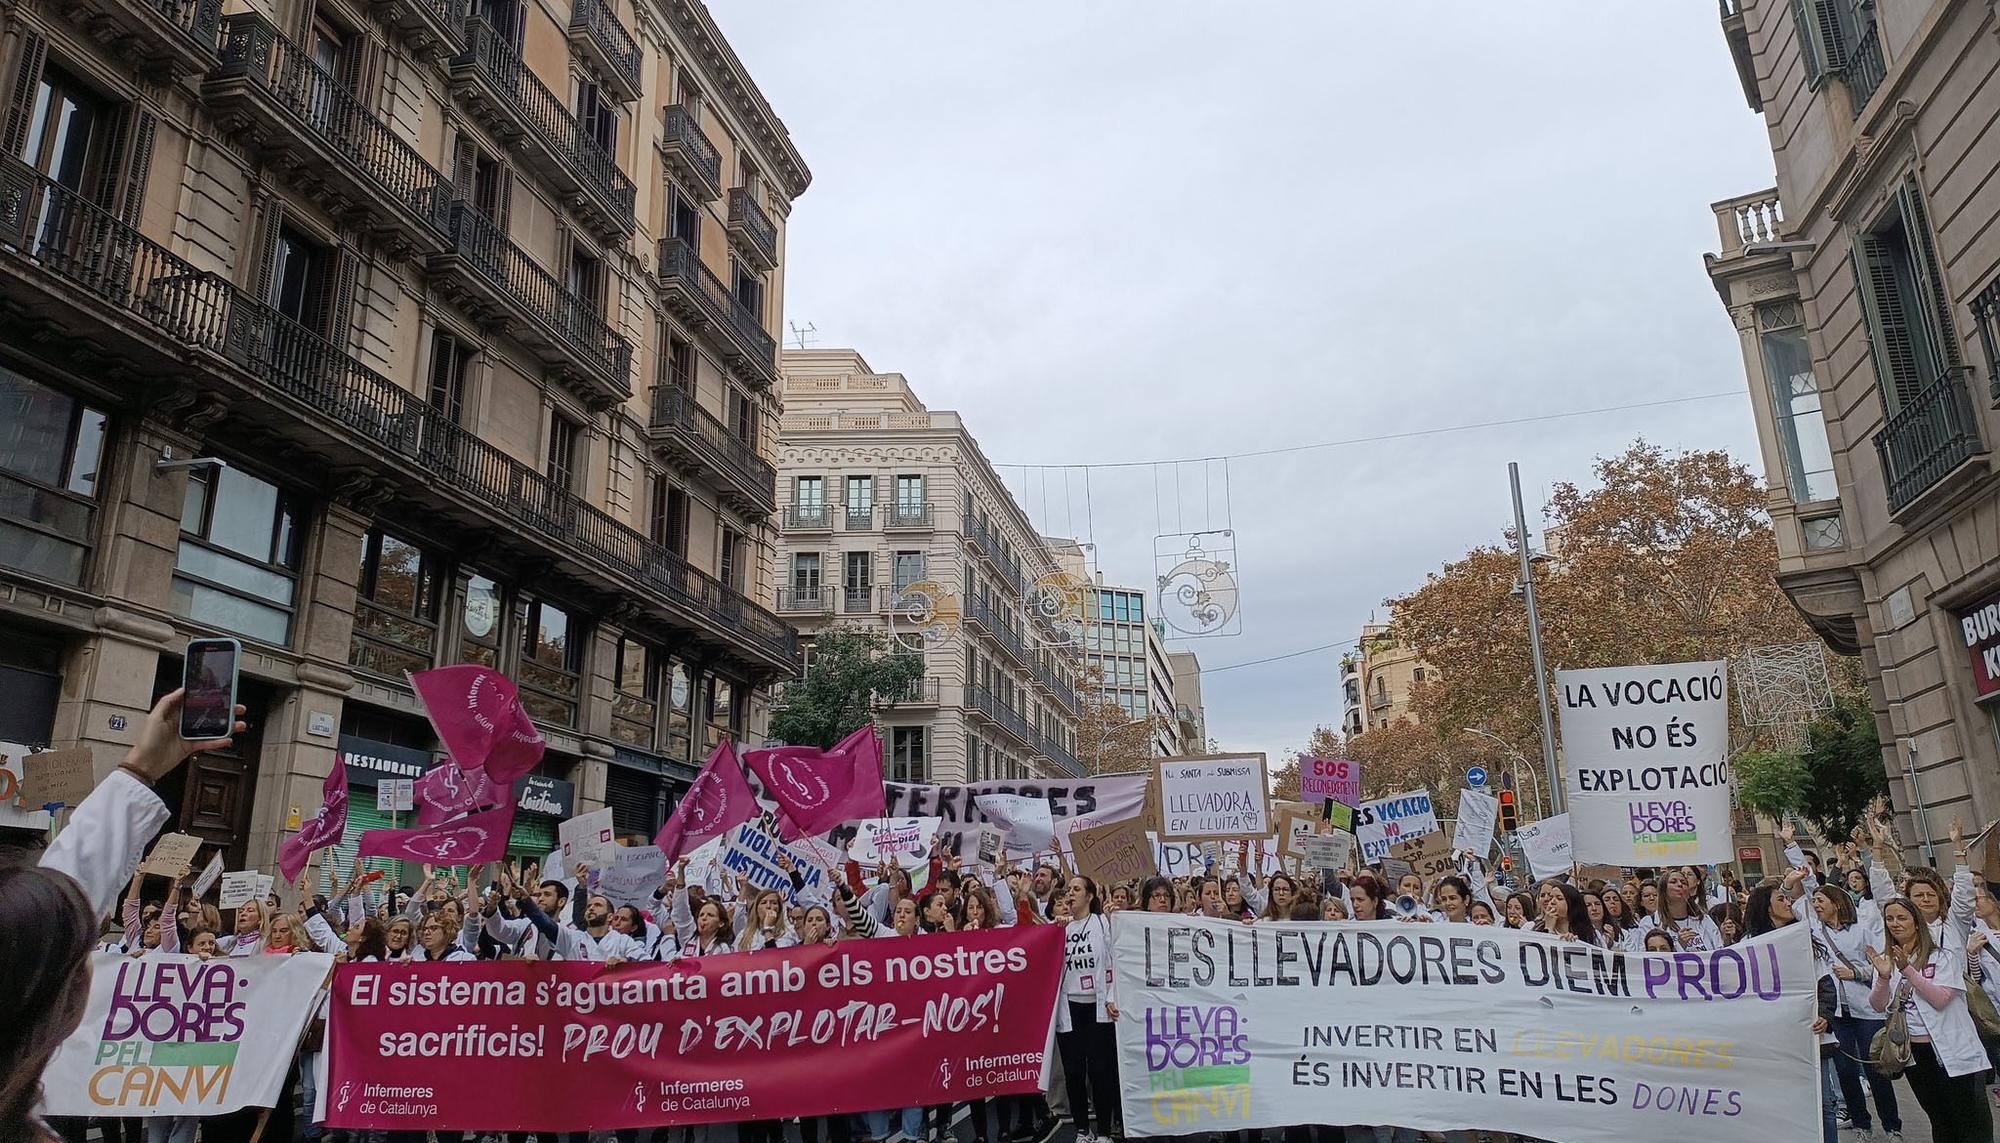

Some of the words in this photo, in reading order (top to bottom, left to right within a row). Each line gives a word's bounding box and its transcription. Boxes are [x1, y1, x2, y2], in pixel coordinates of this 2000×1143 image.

[1962, 601, 2000, 647] BUR
[1565, 684, 1597, 708] LA
[1602, 668, 1722, 707] VOCACIÓ
[1611, 725, 1656, 750] NO
[1666, 716, 1697, 748] ÉS
[344, 752, 422, 777] RESTAURANT
[1180, 768, 1201, 779] SANTA
[1217, 767, 1251, 777] SUBMISSA
[1313, 760, 1349, 779] SOS
[1578, 755, 1728, 791] EXPLOTACIÓ
[1170, 790, 1251, 813] LLEVADORA
[1171, 819, 1188, 831] EN
[1199, 814, 1240, 830] LLUITA
[1383, 822, 1400, 838] NO
[1631, 815, 1696, 835] DORES
[1633, 832, 1657, 844] PEL
[1116, 844, 1137, 862] DIEM
[1065, 944, 1092, 956] LIKE
[1066, 958, 1095, 971] THIS
[1145, 927, 1215, 988] LES
[1228, 928, 1505, 988] LLEVADORES
[1519, 940, 1631, 996] DIEM
[1643, 943, 1781, 1001] PROU
[351, 975, 381, 1006] El
[388, 974, 526, 1006] sistema
[535, 972, 707, 1014] s'aguanta
[720, 960, 806, 998] amb
[818, 954, 873, 989] els
[885, 946, 1028, 982] nostres
[102, 1000, 246, 1042] DORES
[379, 1024, 545, 1057] sacrificis!
[562, 1022, 664, 1063] PROU
[678, 982, 1005, 1055] D'EXPLOTAR-NOS!
[1303, 1024, 1442, 1051] INVERTIR
[1454, 1027, 1498, 1053] EN
[95, 1041, 149, 1066] PEL
[966, 1052, 1043, 1071] Infermeres
[1146, 1034, 1252, 1072] DORES
[88, 1065, 232, 1106] CANVI
[660, 1079, 744, 1096] Infermeres
[966, 1074, 983, 1088] de
[986, 1067, 1040, 1085] Cataluny
[1293, 1054, 1330, 1087] ÉS
[1343, 1061, 1487, 1095] INVERTIR
[1498, 1068, 1543, 1099] EN
[1555, 1073, 1618, 1105] LES
[1632, 1082, 1742, 1117] DONES
[364, 1083, 434, 1098] Infermeres
[360, 1101, 376, 1115] de
[379, 1100, 438, 1118] Catalunya
[660, 1099, 679, 1112] de
[682, 1094, 750, 1111] Catalunya
[1151, 1084, 1250, 1126] CANVI
